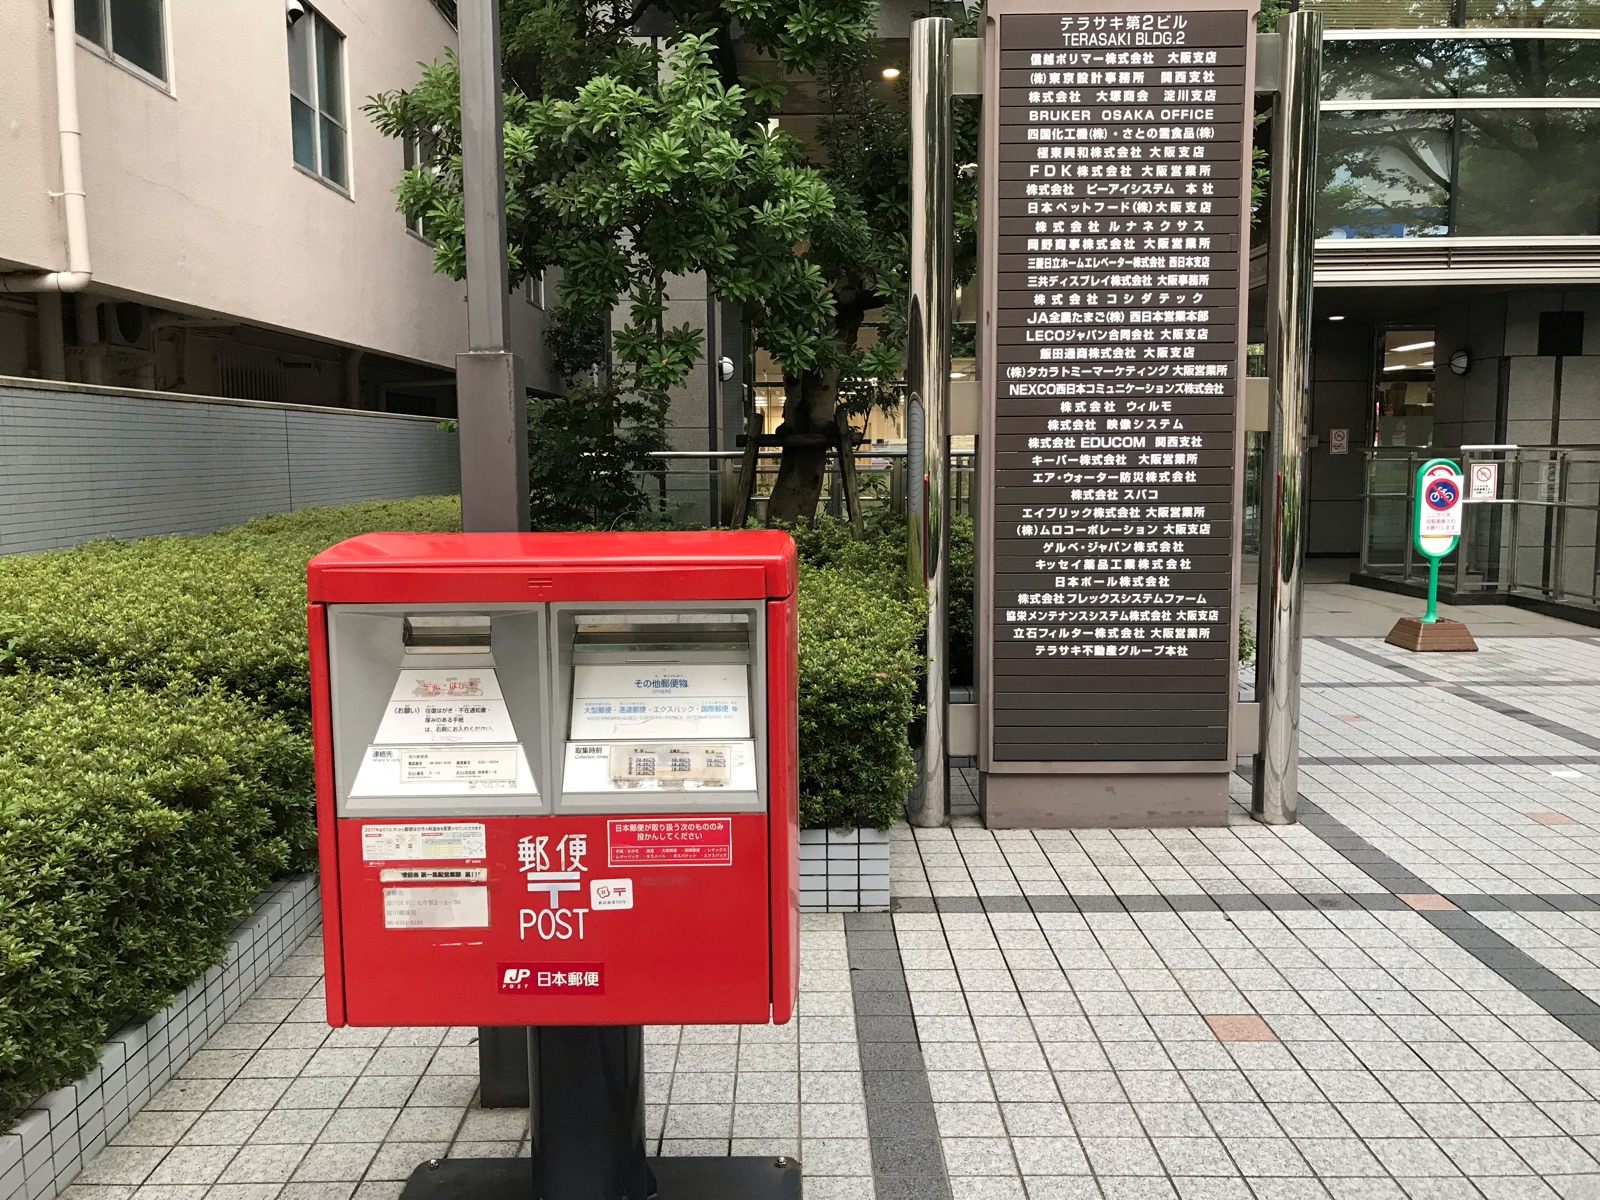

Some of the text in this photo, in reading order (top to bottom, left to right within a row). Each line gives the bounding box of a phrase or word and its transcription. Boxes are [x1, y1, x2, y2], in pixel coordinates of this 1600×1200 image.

[1061, 15, 1187, 32] テラサキ第2ビル
[1063, 31, 1185, 46] TERASAKI BLDG.2
[1031, 51, 1216, 65] 信越ポリマー株式会社 大阪支店
[1031, 71, 1214, 84] (株)東京設計事務所 関西支社
[1029, 90, 1216, 103] 株式会社 大塚商会 淀川支店
[1030, 109, 1213, 121] BRUKER OSAKA OFFICE
[1150, 146, 1204, 157] 大阪支店
[1142, 165, 1211, 176] 大阪営業所
[1026, 184, 1074, 195] 株式会社
[1186, 183, 1213, 194] 本社
[1035, 221, 1204, 232] 株式会社 ルナネクサス
[1144, 238, 1210, 249] 大阪営業所
[1028, 256, 1210, 269] 三菱日立ホームエレベーター株式会社 西日本支店
[1028, 274, 1209, 287] 三共ディスプレイ株式会社 大阪事務所
[1034, 293, 1202, 305] 株式会社 コシダテック
[1130, 311, 1208, 322] 西日本営業本部
[1027, 328, 1208, 341] LECOジャパン合同会社 大阪支店
[1144, 347, 1194, 358] 大阪支店
[1173, 365, 1227, 376] 大阪営業所
[1010, 383, 1224, 395] NEXCO西日本コミュニケーションズ株式会社
[1060, 401, 1171, 412] 株式会社 ウィルモ
[1048, 419, 1183, 431] 株式会社 映像システム
[1028, 436, 1202, 448] 株式会社 EDUCOM 関西支社
[1139, 454, 1198, 465] 大阪営業所
[1071, 489, 1118, 500] 株式会社
[1022, 507, 1205, 518] エイブリック株式会社 大阪営業所
[1164, 524, 1210, 534] 大阪支店
[1036, 559, 1191, 570] キッセイ薬品工業株式会社
[1006, 610, 1218, 621] 協栄メンテナンスシステム株式会社 大阪支店
[1013, 628, 1210, 638] 立石フィルター株式会社 大阪営業所
[635, 679, 688, 688] その他郵便物
[616, 823, 723, 832] 日本郵便が取り扱う次のもののみ
[637, 833, 702, 841] 投かんしてください
[518, 833, 588, 872] 郵便
[520, 909, 589, 940] POST
[538, 971, 599, 987] 日本郵便
